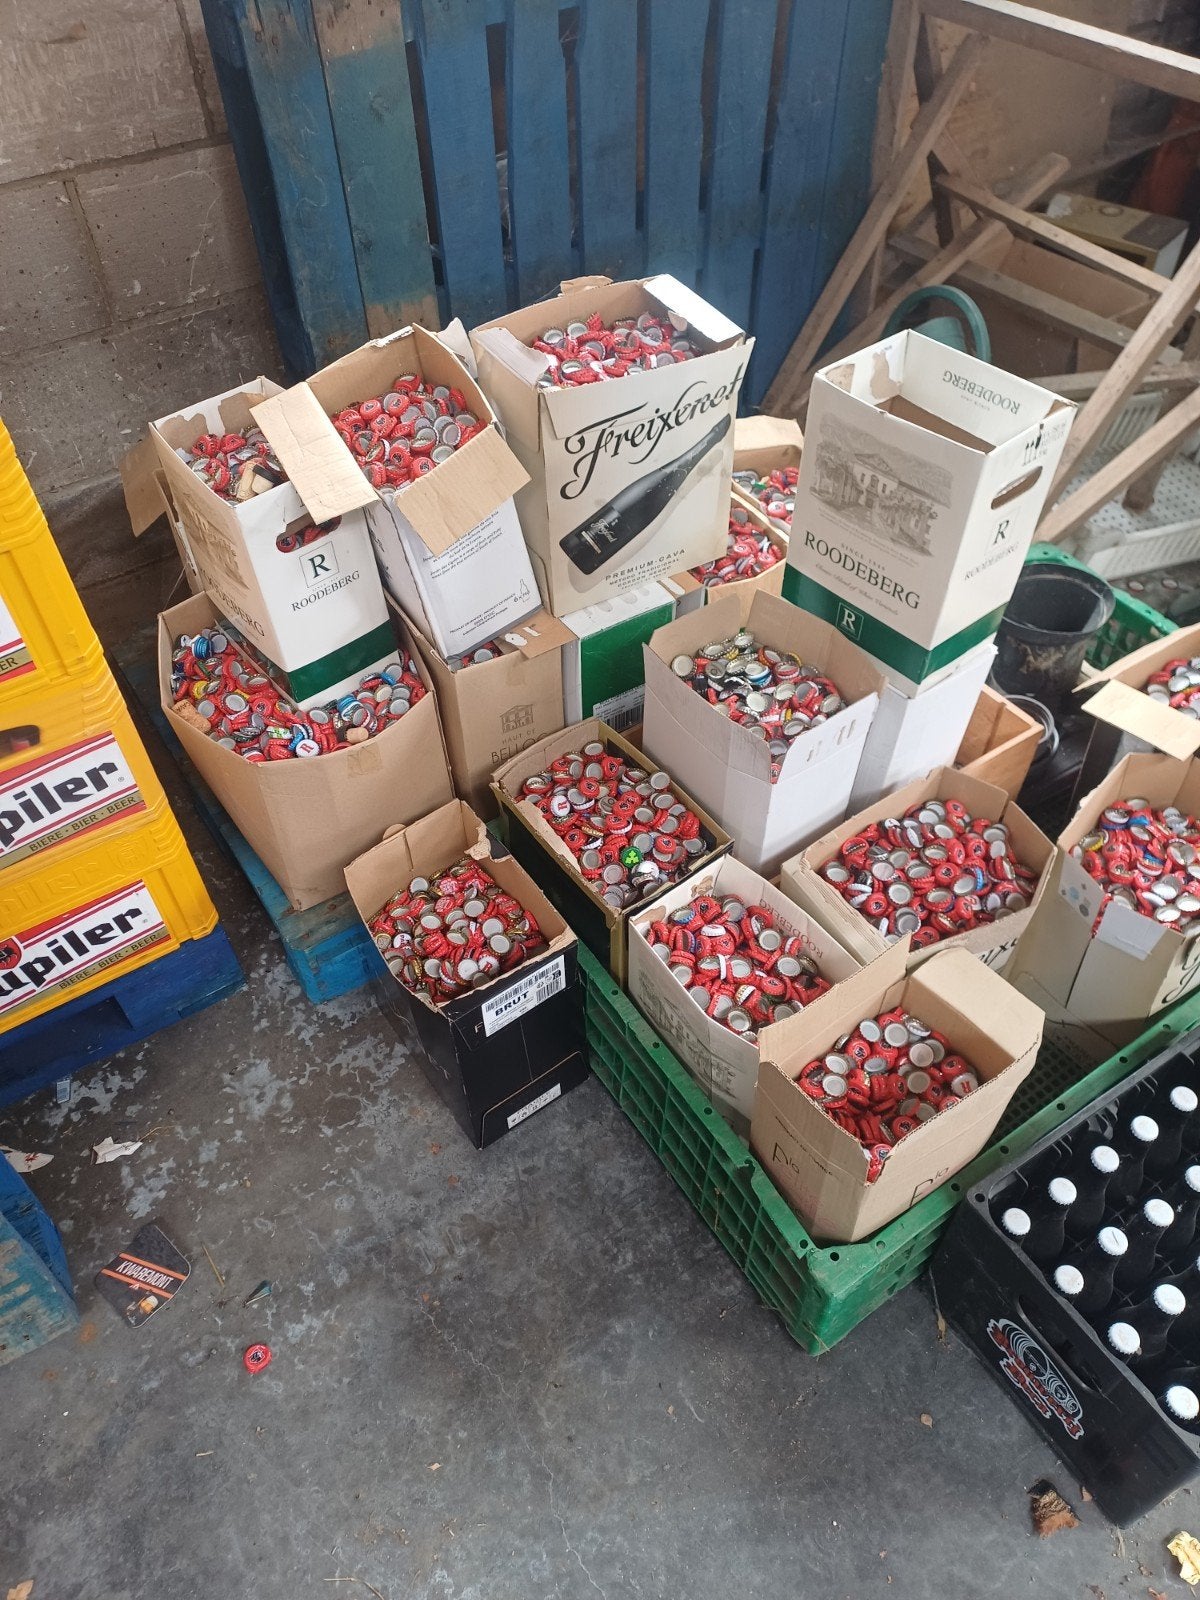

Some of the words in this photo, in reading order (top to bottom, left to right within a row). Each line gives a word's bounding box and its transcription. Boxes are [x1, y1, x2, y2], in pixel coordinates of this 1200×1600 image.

[942, 369, 1021, 415] ROODEBERG
[560, 362, 744, 500] Freixenet
[994, 519, 1010, 545] R
[308, 553, 331, 579] R
[804, 530, 920, 610] ROODEBERG
[291, 570, 360, 611] ROODEBERG
[841, 608, 856, 630] R
[71, 814, 99, 831] BIER
[107, 797, 136, 814] BEER
[98, 953, 124, 968] BIER
[130, 934, 160, 951] BEER
[495, 990, 530, 1017] BRUT
[116, 1260, 174, 1289] KWAREMONT
